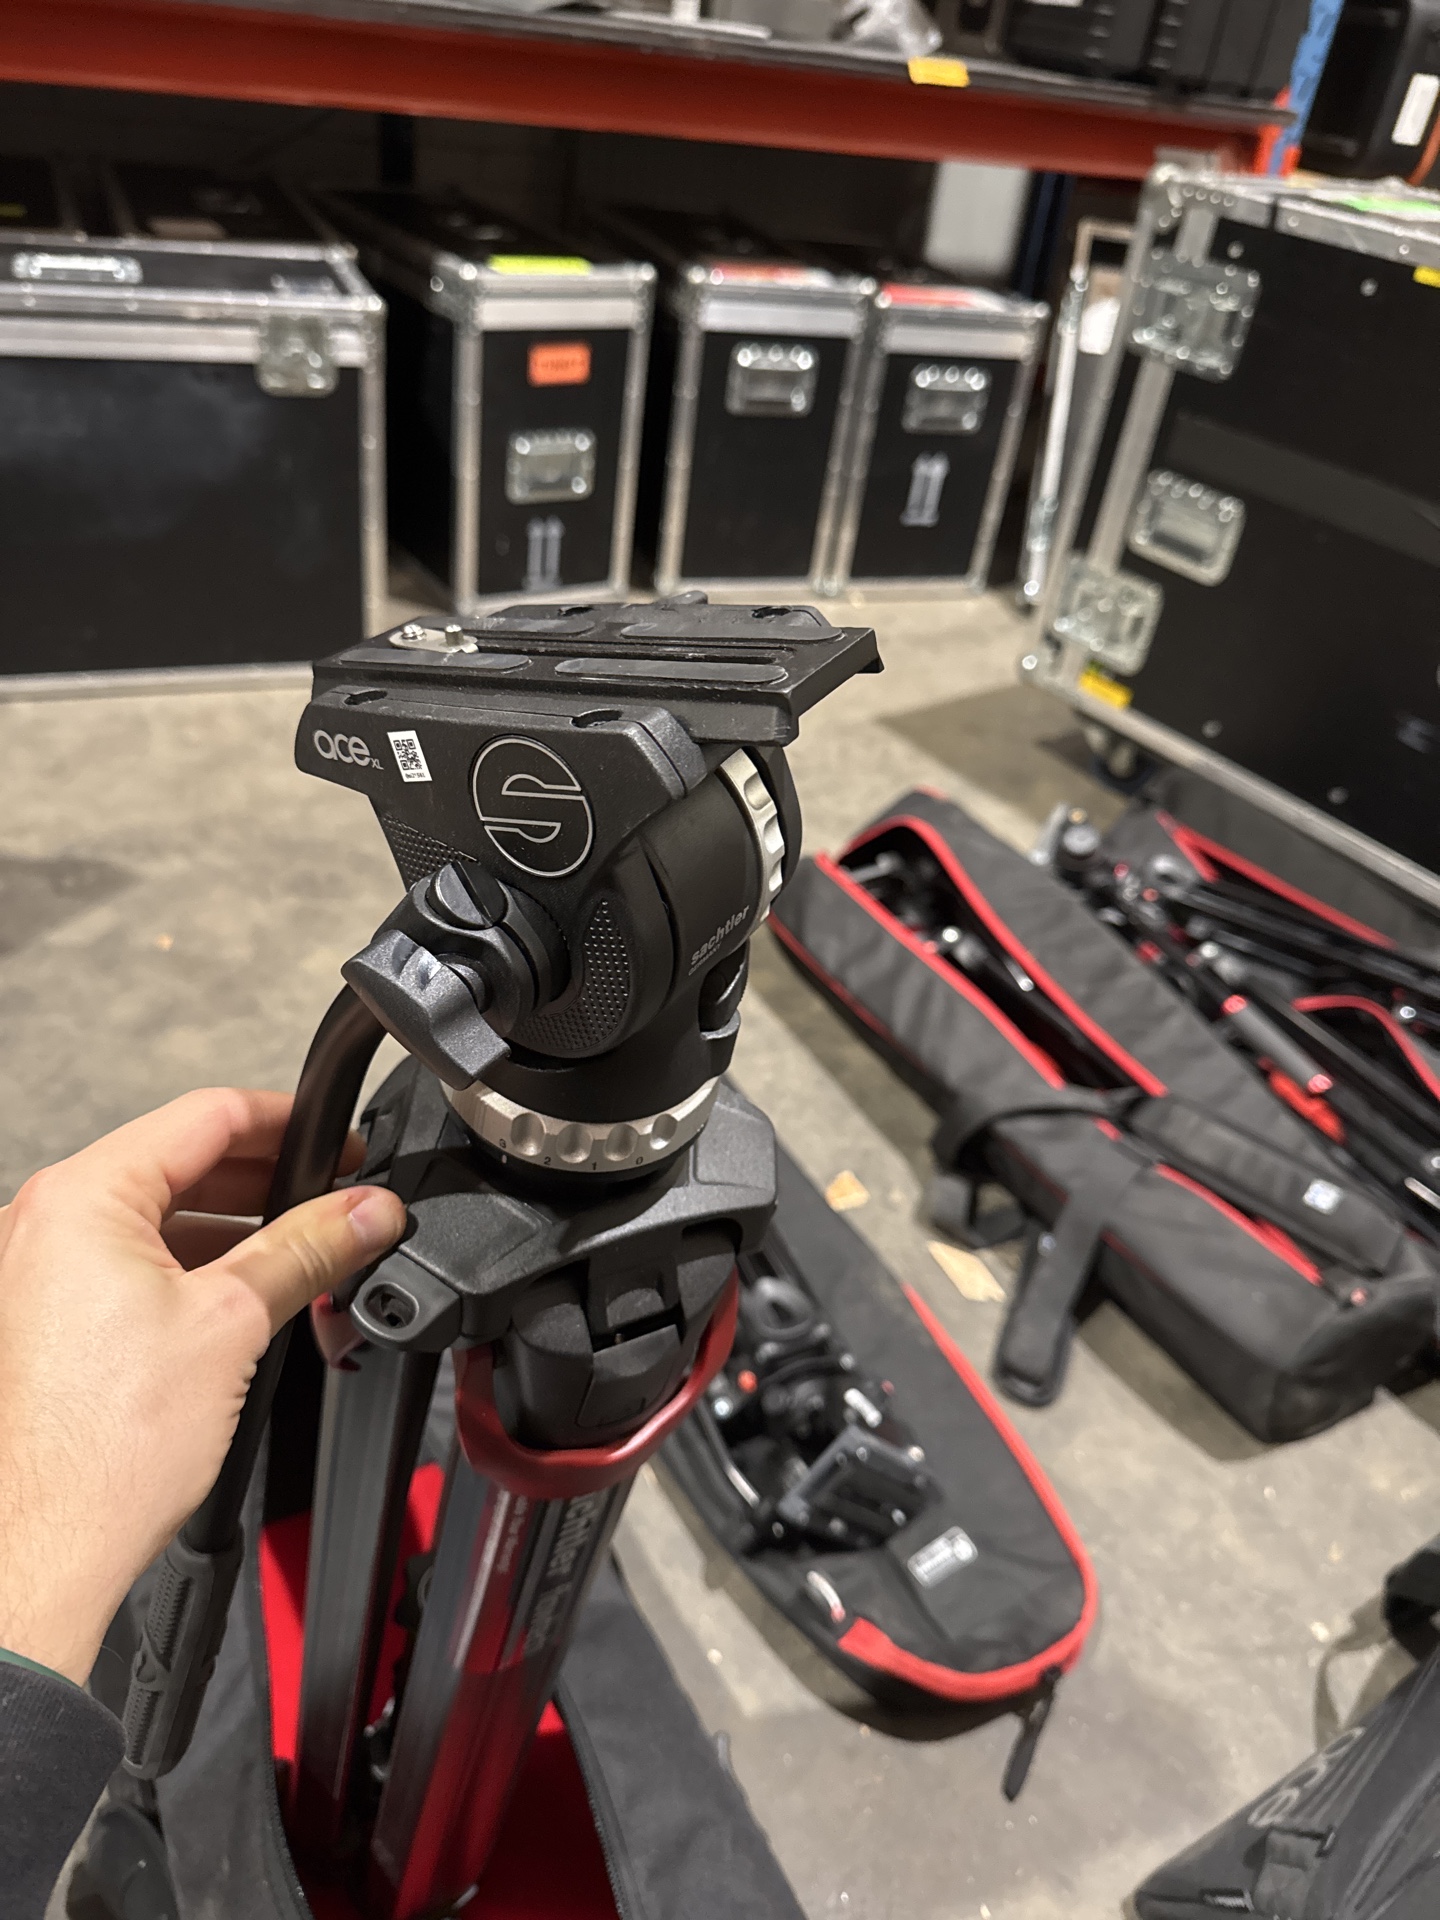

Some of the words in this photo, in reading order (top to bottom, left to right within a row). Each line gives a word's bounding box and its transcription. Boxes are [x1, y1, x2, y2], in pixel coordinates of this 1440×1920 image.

[313, 729, 371, 767] ace
[369, 757, 385, 771] XL
[690, 905, 750, 966] sachtler
[543, 1156, 552, 1166] 2
[591, 1161, 598, 1171] 1
